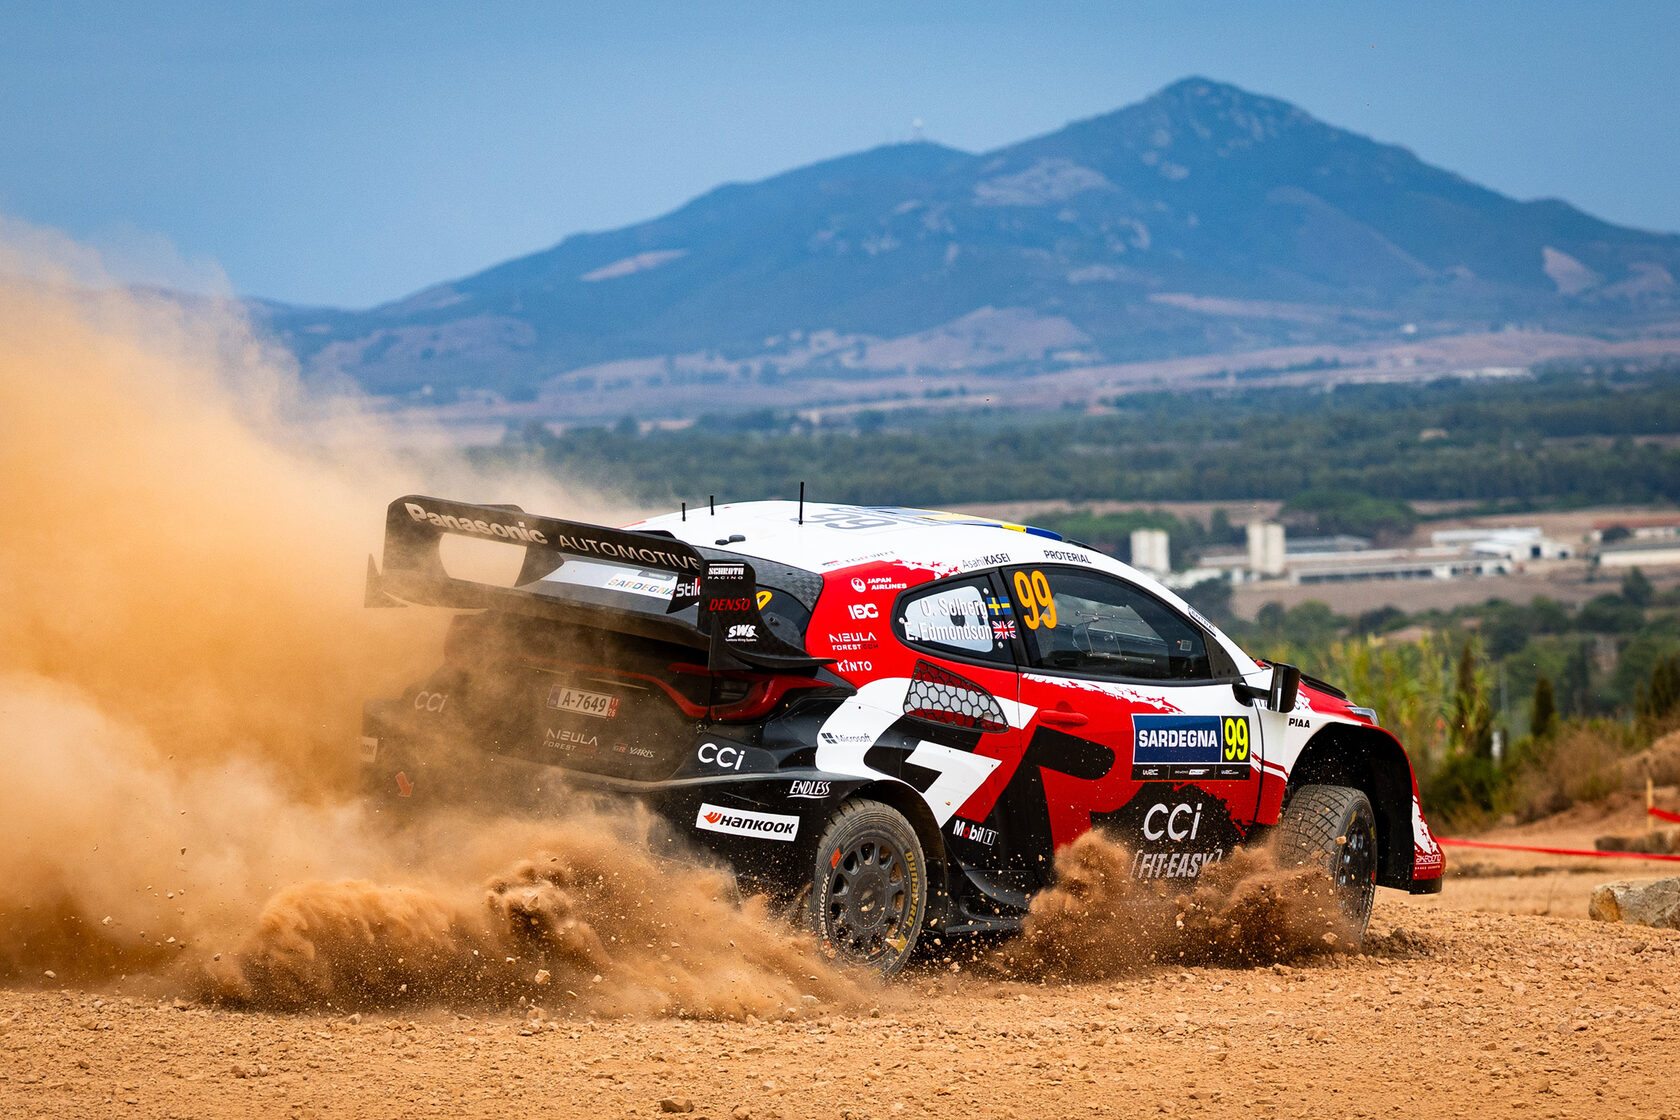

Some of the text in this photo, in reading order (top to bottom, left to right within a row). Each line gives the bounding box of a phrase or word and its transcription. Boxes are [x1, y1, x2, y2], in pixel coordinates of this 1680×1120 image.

[404, 502, 700, 570] Panasonic AUTOMOTIVE
[1043, 550, 1092, 564] PROTERIAL
[708, 567, 744, 575] SCHROTH
[608, 579, 676, 596] SARDEGNA
[709, 598, 751, 611] DENSO
[939, 597, 987, 619] Solberg
[1013, 570, 1057, 630] 99
[728, 624, 759, 638] SWS
[904, 621, 993, 641] E. Edmondson
[561, 691, 607, 712] A-7649
[1288, 718, 1311, 728] PIAA
[836, 734, 872, 743] Microsoft
[1138, 718, 1249, 761] SARDEGNA 99
[629, 746, 656, 759] YARIS
[789, 780, 832, 796] ENDLESS
[952, 819, 985, 843] Mobil
